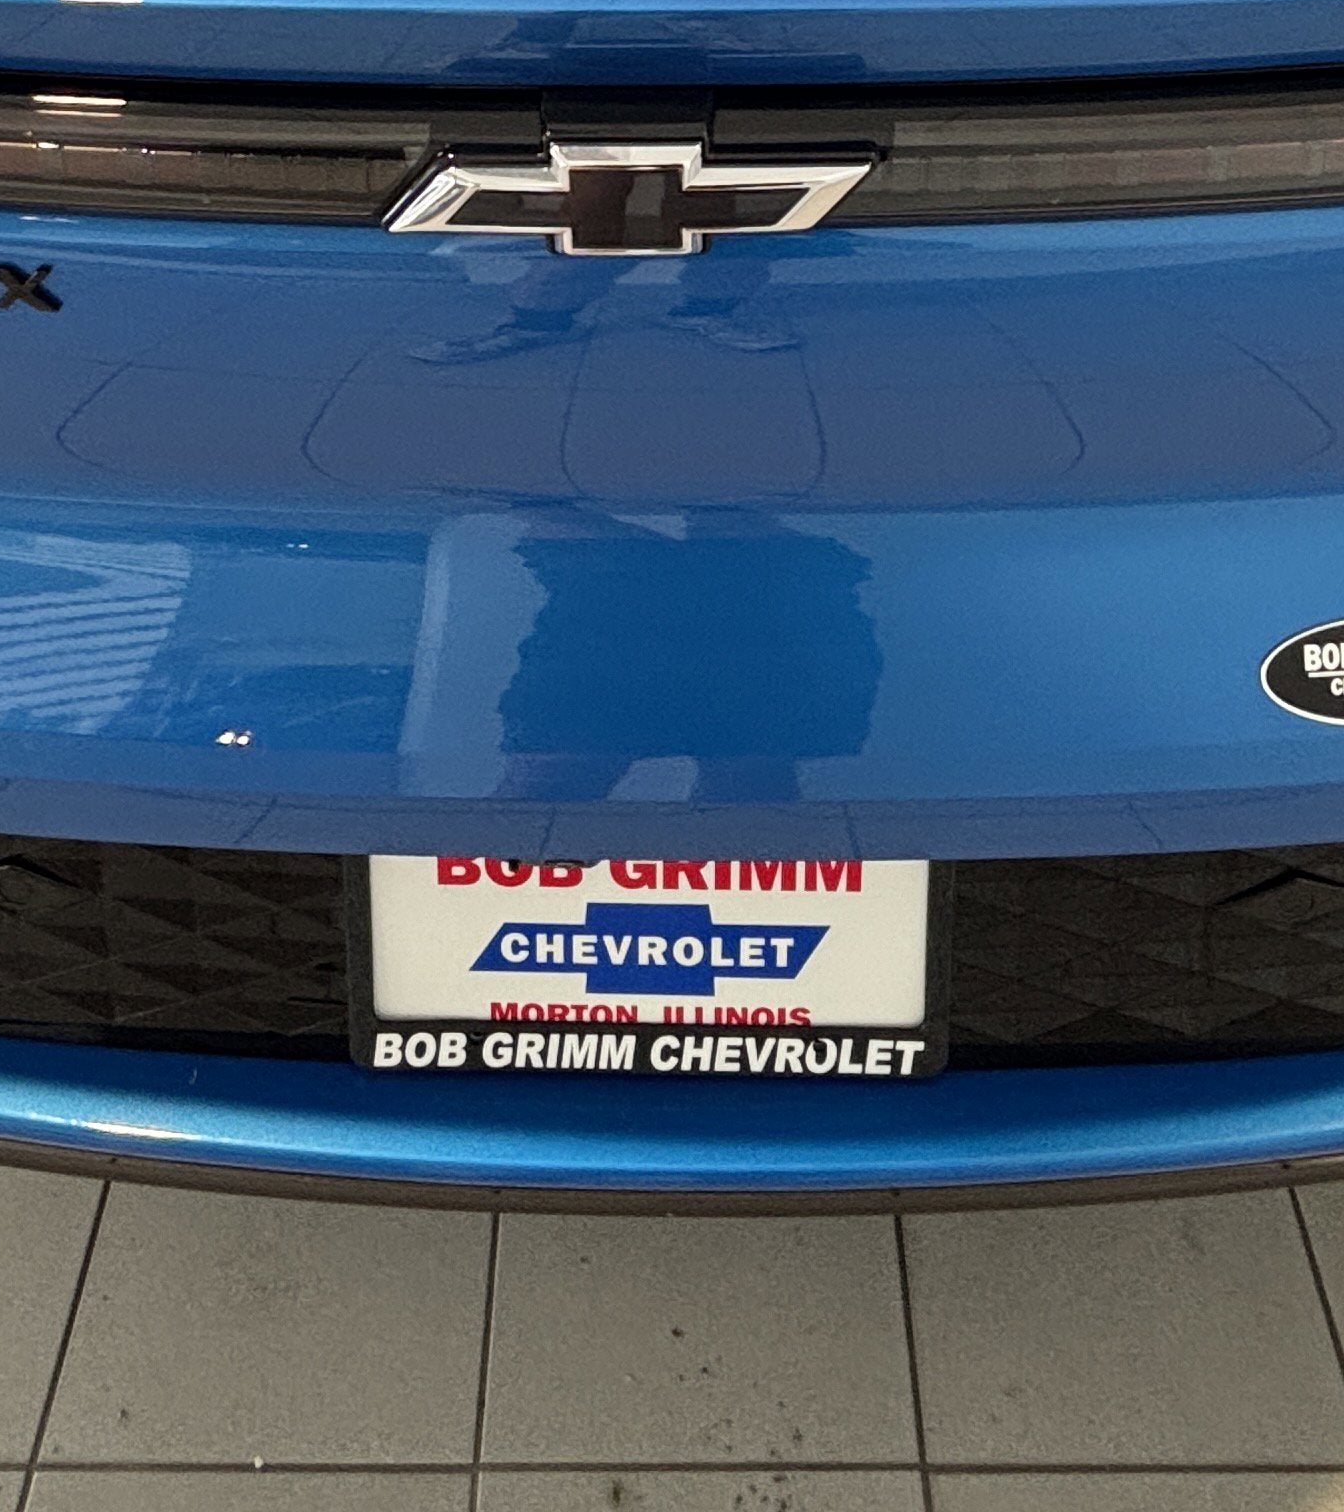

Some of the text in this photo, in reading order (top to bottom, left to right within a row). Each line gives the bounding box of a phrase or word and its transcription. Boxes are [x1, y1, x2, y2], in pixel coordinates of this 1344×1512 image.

[609, 859, 862, 893] GRIMM
[499, 931, 795, 969] CHEVROLET
[490, 1002, 638, 1023] MORTON
[373, 1032, 925, 1076] BOB GRIMM CHEVROLET
